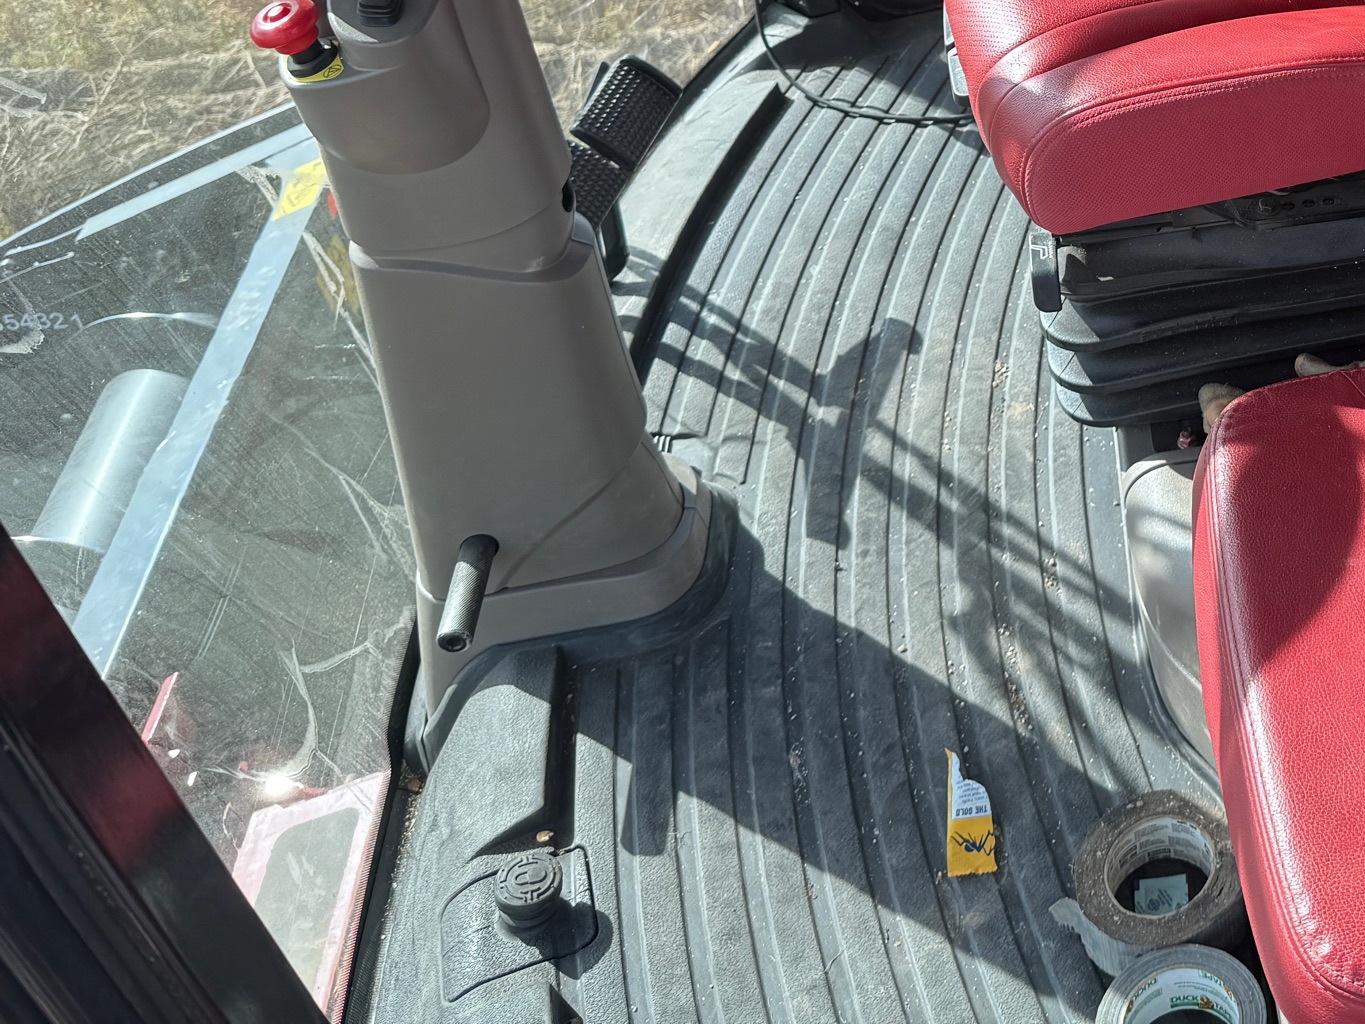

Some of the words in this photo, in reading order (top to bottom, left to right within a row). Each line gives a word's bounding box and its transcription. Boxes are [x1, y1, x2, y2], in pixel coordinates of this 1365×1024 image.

[0, 312, 84, 331] 54321
[956, 806, 973, 817] GOLD
[975, 804, 988, 814] THE
[1170, 994, 1199, 1004] DUCK
